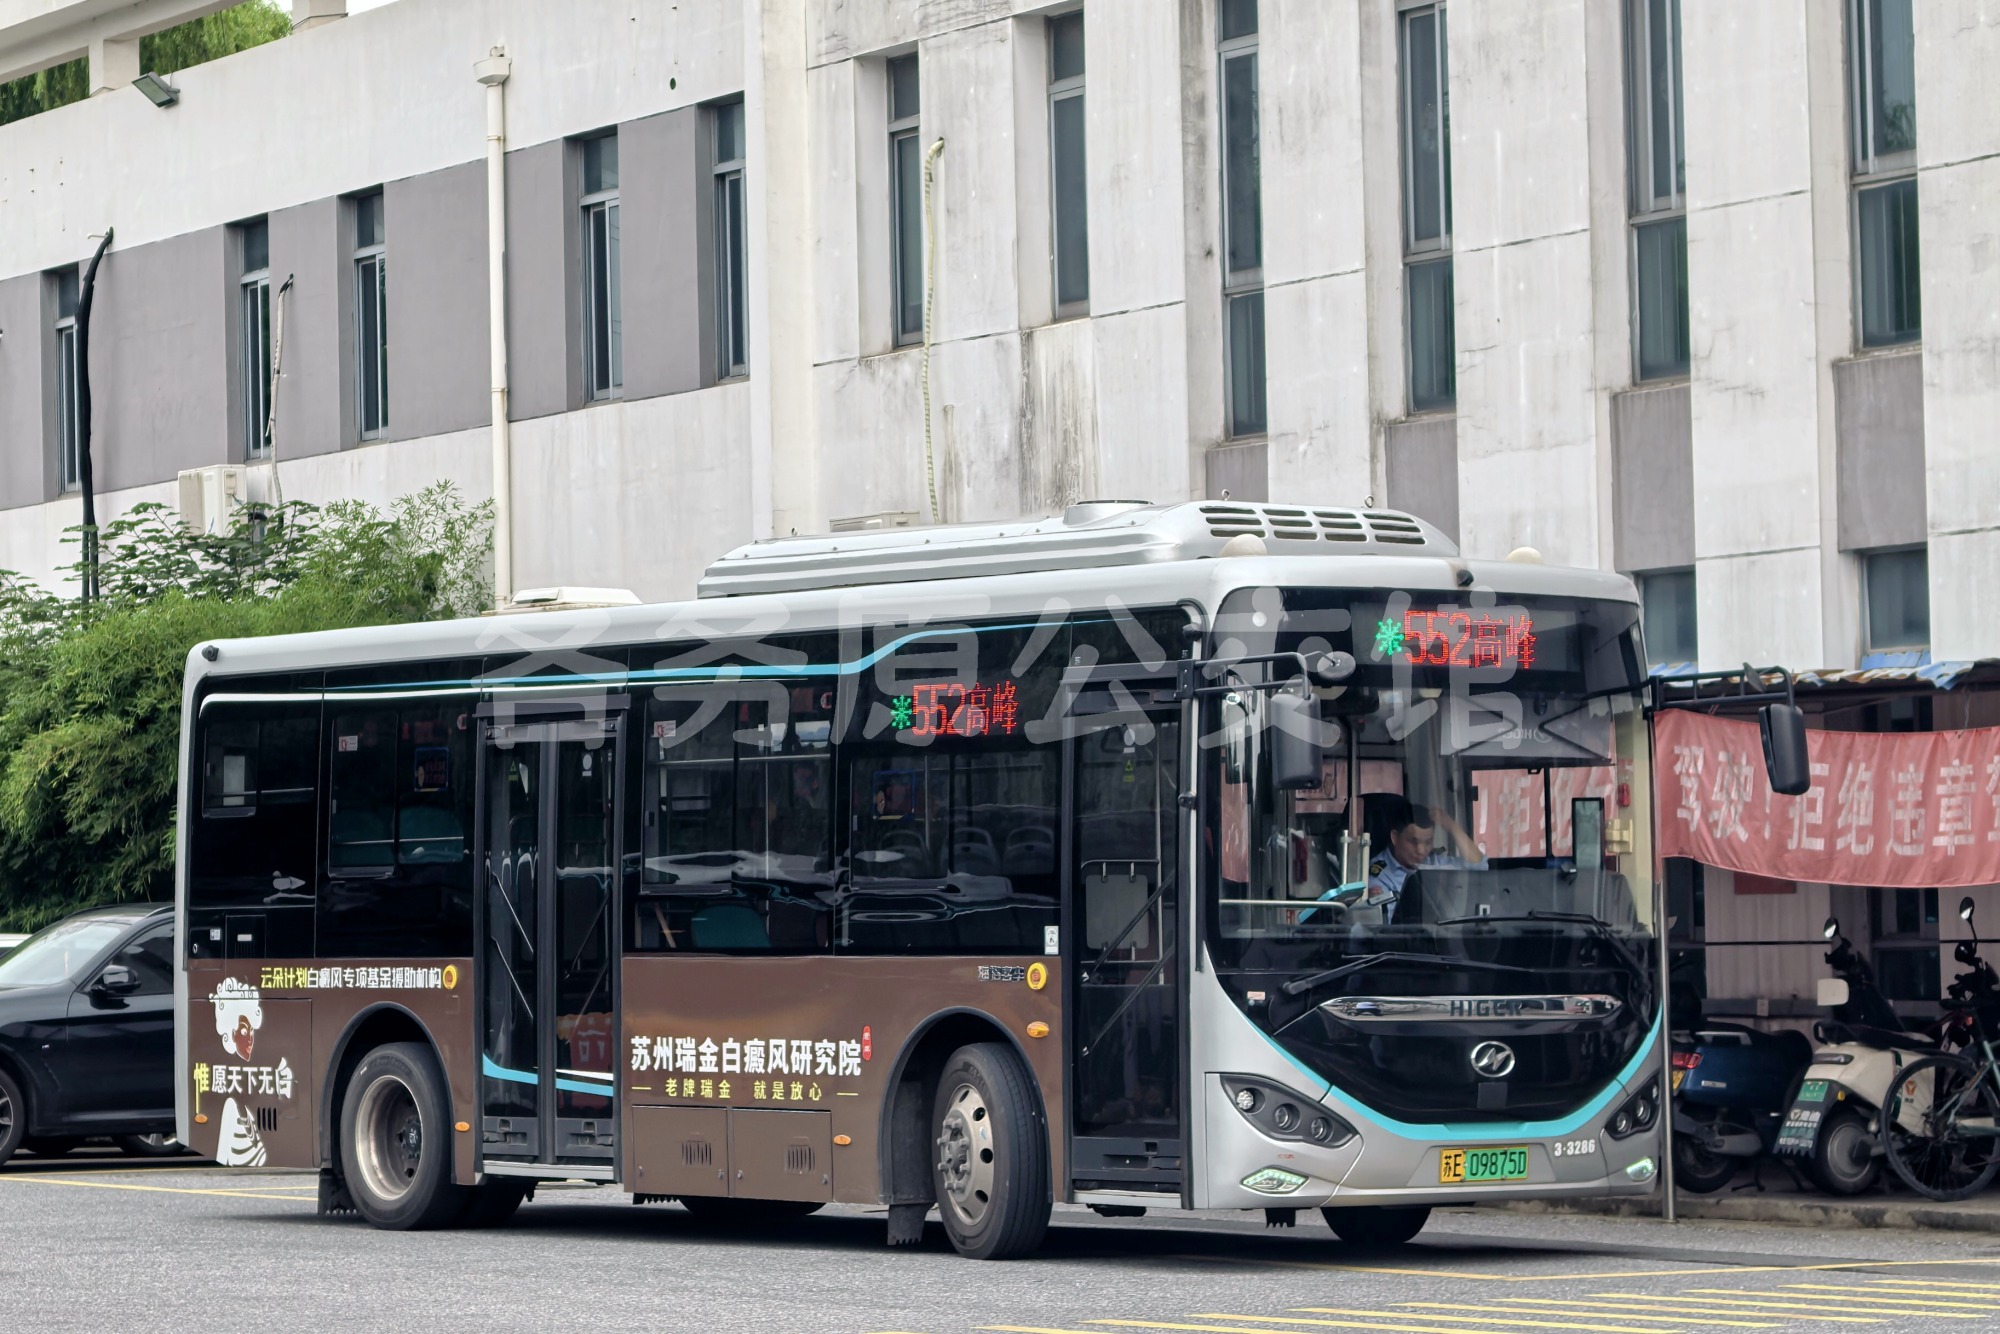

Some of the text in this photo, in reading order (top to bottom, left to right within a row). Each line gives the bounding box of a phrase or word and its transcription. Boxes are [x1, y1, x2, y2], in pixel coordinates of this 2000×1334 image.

[1404, 610, 1537, 669] 552高峰
[912, 680, 1019, 736] 552高峰
[1450, 999, 1522, 1017] HIGER
[630, 1035, 861, 1077] 苏州瑞金白癜风研究院
[665, 1077, 823, 1102] 老牌瑞金 就是放心
